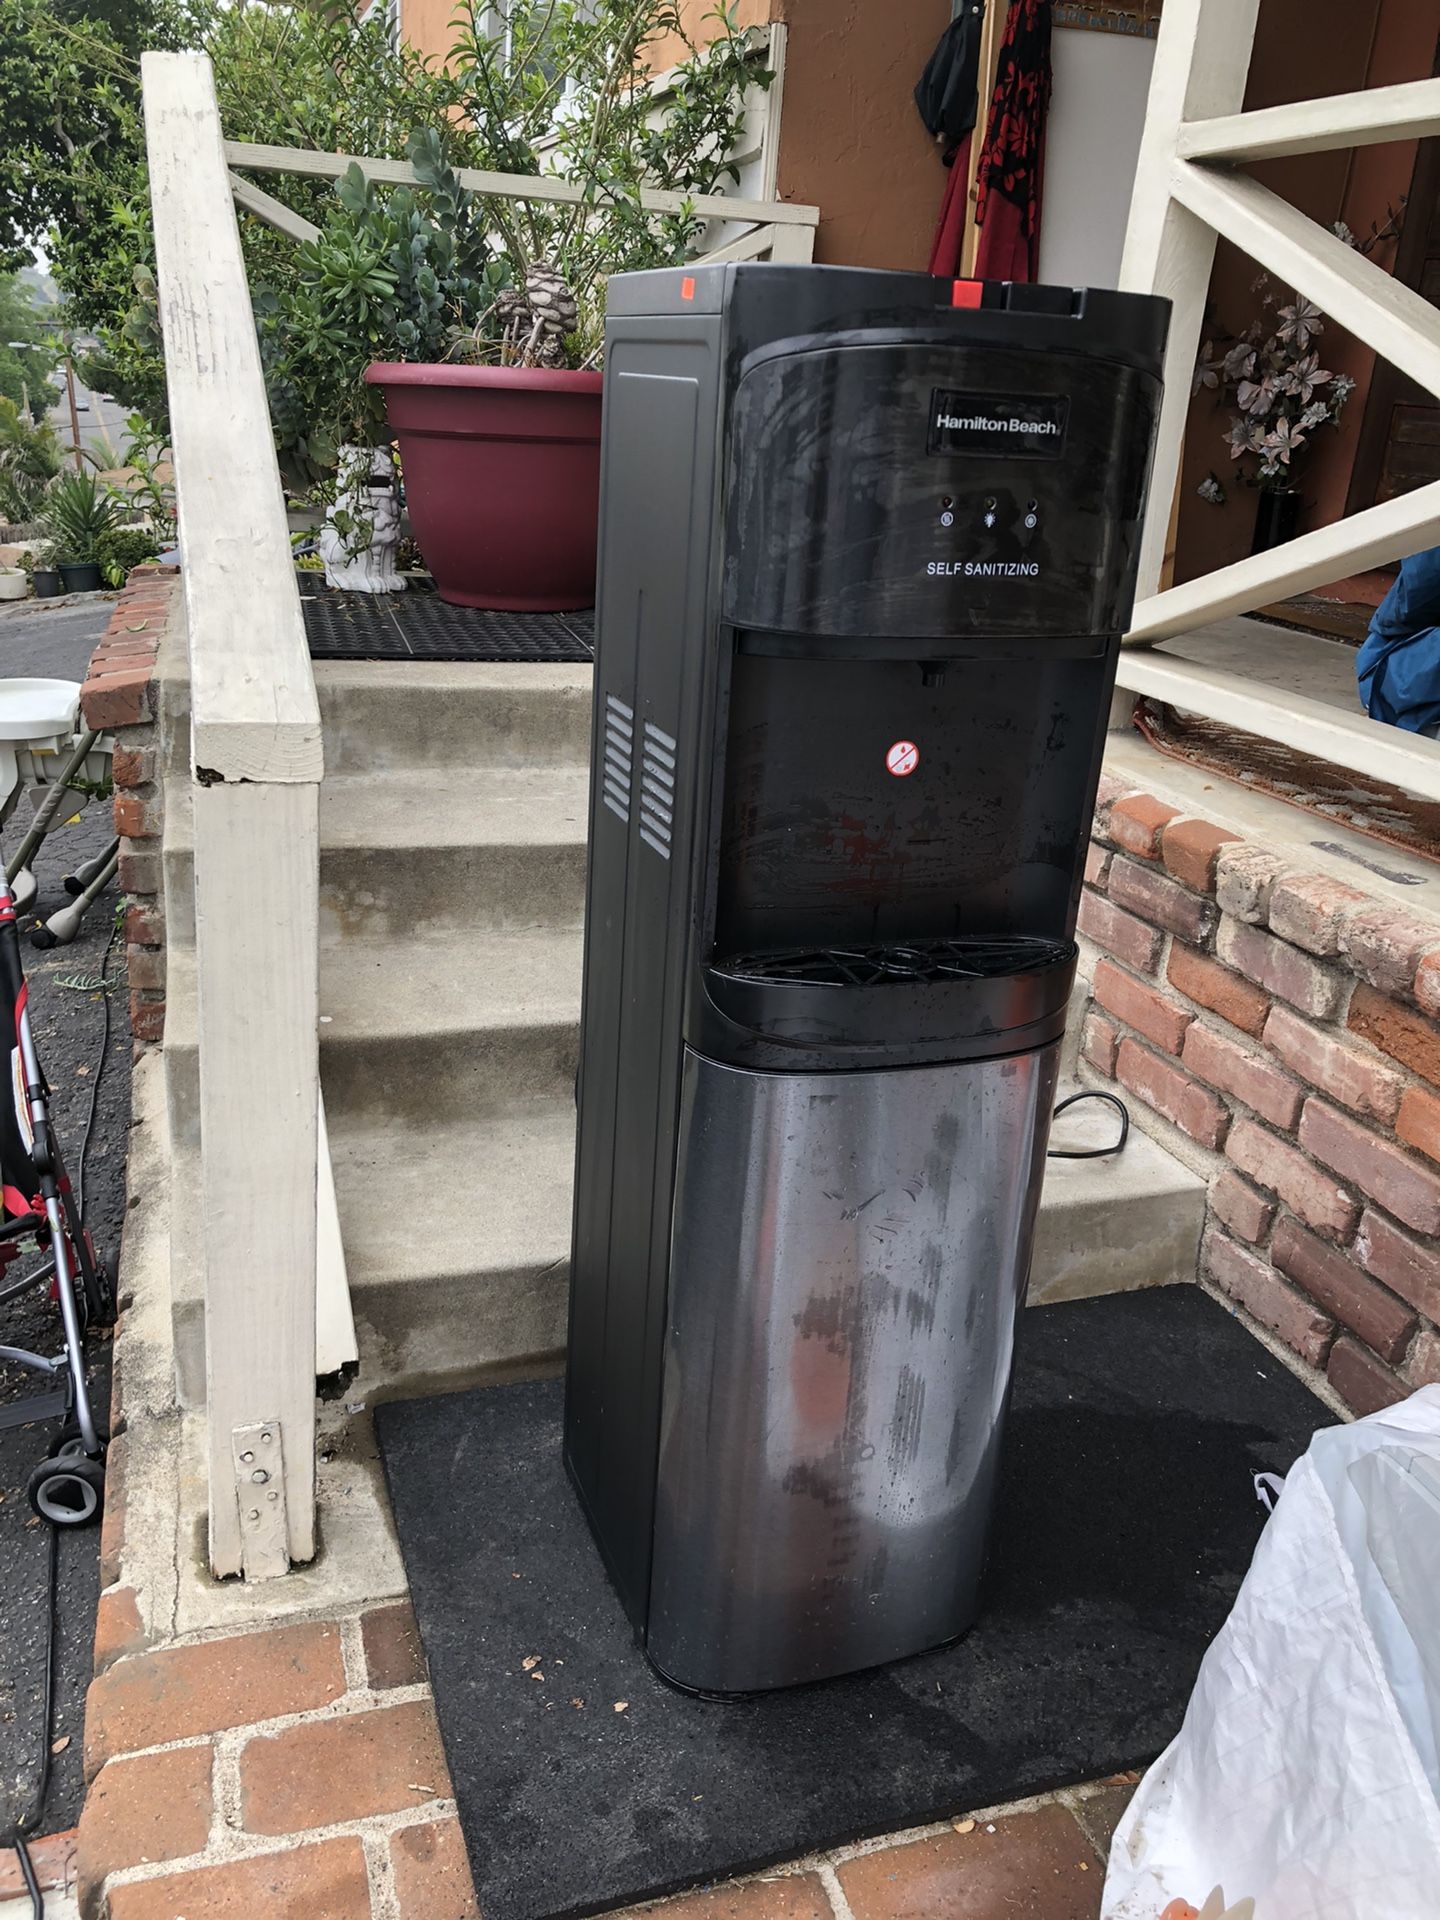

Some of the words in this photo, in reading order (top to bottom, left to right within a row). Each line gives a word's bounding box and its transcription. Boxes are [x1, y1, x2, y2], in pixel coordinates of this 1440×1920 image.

[937, 414, 1008, 431] Hamilton
[927, 562, 962, 575] SELF
[964, 562, 1039, 576] SANITIZING
